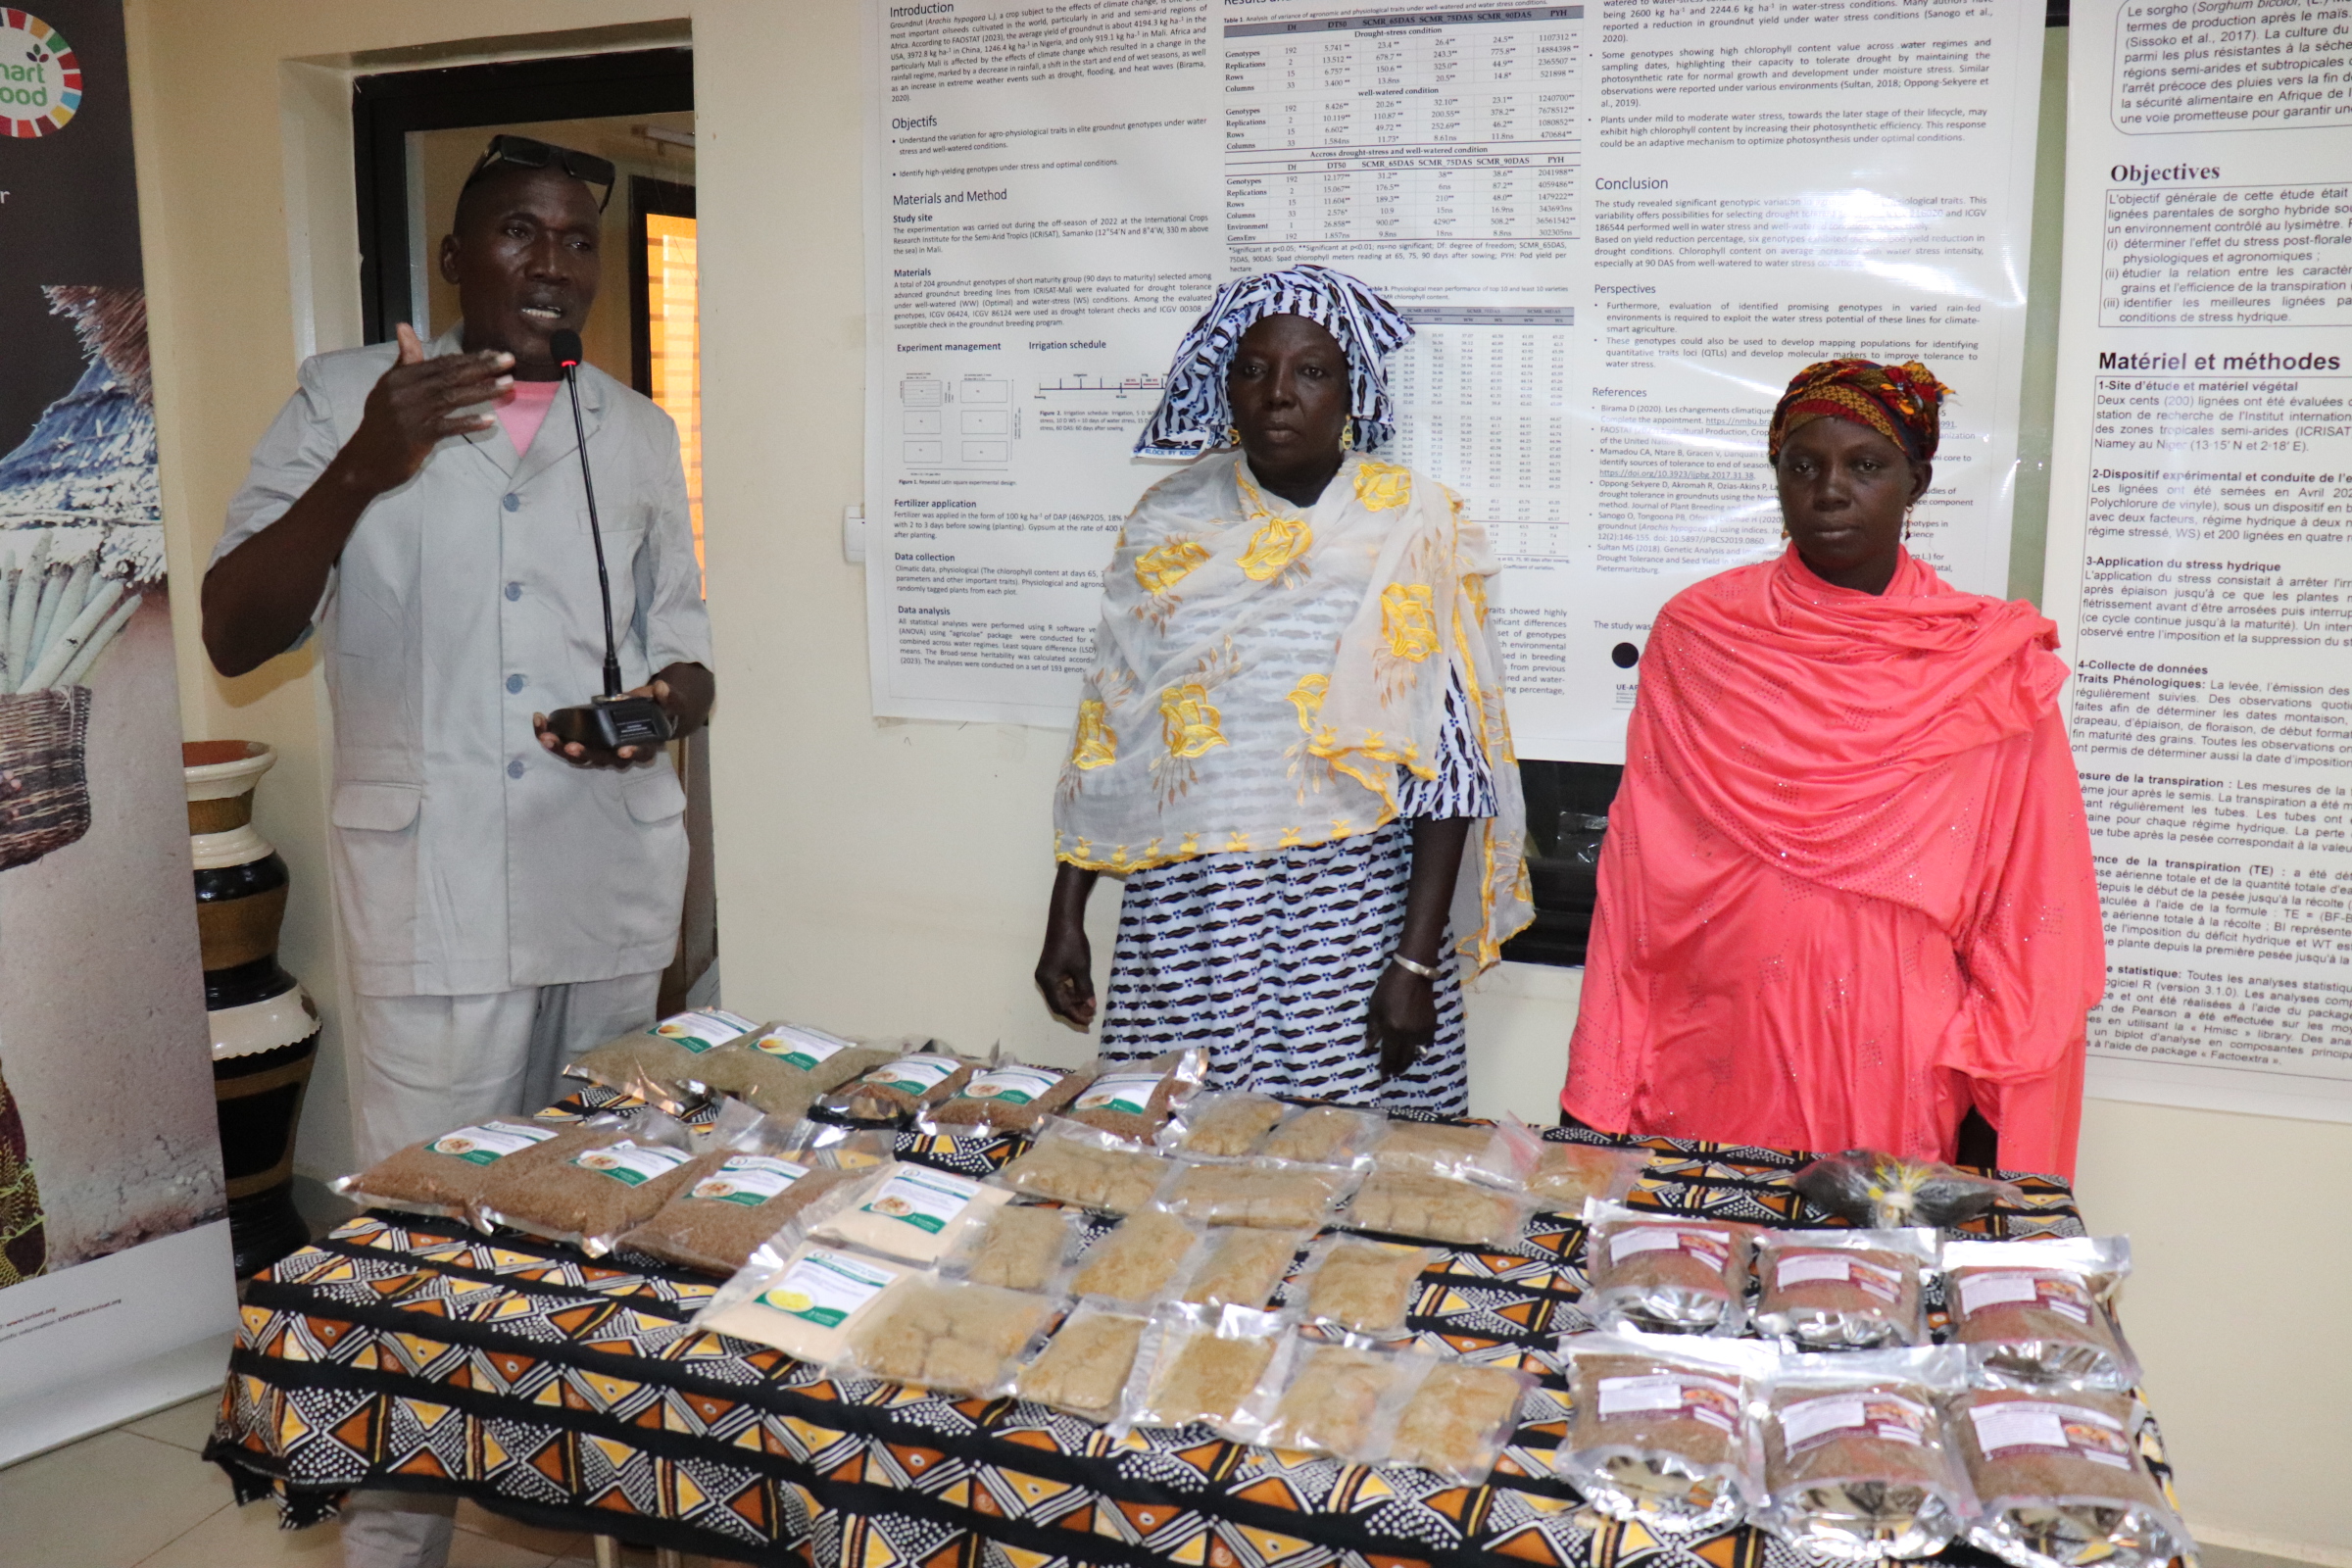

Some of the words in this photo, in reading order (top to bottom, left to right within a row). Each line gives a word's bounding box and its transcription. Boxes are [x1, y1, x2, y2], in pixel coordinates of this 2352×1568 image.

[890, 2, 954, 17] Introduction
[1362, 16, 1415, 26] SCMR_65DAS
[1418, 14, 1473, 24] SCMR_75DAS
[1477, 10, 1532, 21] SCMR_90DAS
[2126, 21, 2167, 32] termes
[2171, 19, 2187, 29] de
[2191, 15, 2256, 30] production
[2260, 11, 2296, 25] après
[2300, 10, 2312, 21] le
[1354, 29, 1407, 38] Drought-stress
[1408, 26, 1442, 34] condition
[1225, 61, 1266, 71] Replications
[1357, 87, 1404, 96] well-watered
[1600, 115, 1625, 123] Plants
[1627, 114, 1652, 123] under
[1655, 114, 1673, 122] mild
[1687, 113, 1728, 121] moderate
[1787, 110, 1822, 119] towards
[1825, 110, 1840, 118] the
[1842, 110, 1863, 118] later
[1865, 110, 1889, 119] stage
[1891, 108, 1901, 117] of
[1903, 108, 1924, 117] their
[1968, 109, 1988, 117] may
[891, 114, 937, 130] Objectifs
[1338, 148, 1389, 158] drought-stress
[2110, 163, 2220, 185] Objectives
[1595, 176, 1668, 190] Conclusion
[892, 192, 942, 205] Materials
[966, 188, 1007, 201] Method
[2109, 193, 2160, 206] L'objectif
[2165, 192, 2217, 205] générale
[2222, 191, 2238, 201] de
[2243, 190, 2274, 201] cette
[2279, 189, 2315, 200] étude
[2320, 187, 2348, 198] était
[2122, 253, 2209, 265] physiologiques
[2211, 252, 2224, 262] et
[2226, 252, 2312, 264] agronomiques
[893, 268, 931, 277] Materials
[1594, 283, 1656, 295] Perspectives
[2118, 312, 2176, 322] conditions
[2180, 312, 2195, 322] de
[2198, 312, 2233, 322] stress
[893, 322, 928, 330] susceptible
[968, 320, 1004, 329] groundnut
[1005, 319, 1034, 328] breeding
[897, 343, 942, 353] Experiment
[944, 343, 1001, 352] management
[1028, 340, 1068, 351] Irrigation
[1069, 339, 1106, 349] schedule
[2099, 352, 2186, 369] Matériel
[2194, 353, 2215, 370] et
[2223, 352, 2340, 370] méthodes
[1592, 386, 1647, 397] References
[2098, 380, 2131, 390] 1-Site
[2134, 380, 2179, 391] d'étude
[2183, 382, 2195, 391] et
[2198, 381, 2248, 391] matériel
[2252, 381, 2298, 393] végétal
[894, 498, 929, 507] Fertilizer
[931, 499, 976, 509] application
[894, 552, 913, 560] Data
[915, 552, 955, 561] collection
[2086, 556, 2163, 568] 3-Application
[2166, 559, 2182, 568] du
[2185, 560, 2223, 570] stress
[2226, 561, 2281, 573] hydrique
[897, 605, 916, 614] Data
[918, 606, 950, 616] analysis
[1509, 607, 1540, 615] showed
[1543, 608, 1568, 617] highly
[1523, 619, 1567, 627] differences
[1593, 620, 1609, 629] The
[1610, 621, 1634, 631] study
[1513, 629, 1522, 637] of
[1525, 631, 1566, 639] genotypes
[1509, 642, 1566, 650] environmental
[1531, 653, 1566, 663] breeding
[1510, 663, 1529, 671] from
[2077, 659, 2136, 671] 4-Collecte
[2138, 662, 2153, 672] de
[2156, 663, 2208, 675] données
[2078, 673, 2108, 684] Traits
[2113, 674, 2205, 689] Phénologiques:
[2076, 770, 2111, 782] esure
[2115, 772, 2129, 782] de
[2133, 773, 2144, 783] la
[2148, 775, 2223, 787] transpiration
[2094, 1039, 2101, 1048] à
[2104, 1040, 2132, 1051] l'aide
[2134, 1043, 2149, 1052] de
[2150, 1046, 2198, 1058] package
[2210, 1050, 2269, 1064] Factoextra
[58, 1298, 122, 1322] EXPLOREit.icrisat.org
[6, 1307, 57, 1326] www.icrisat.org
